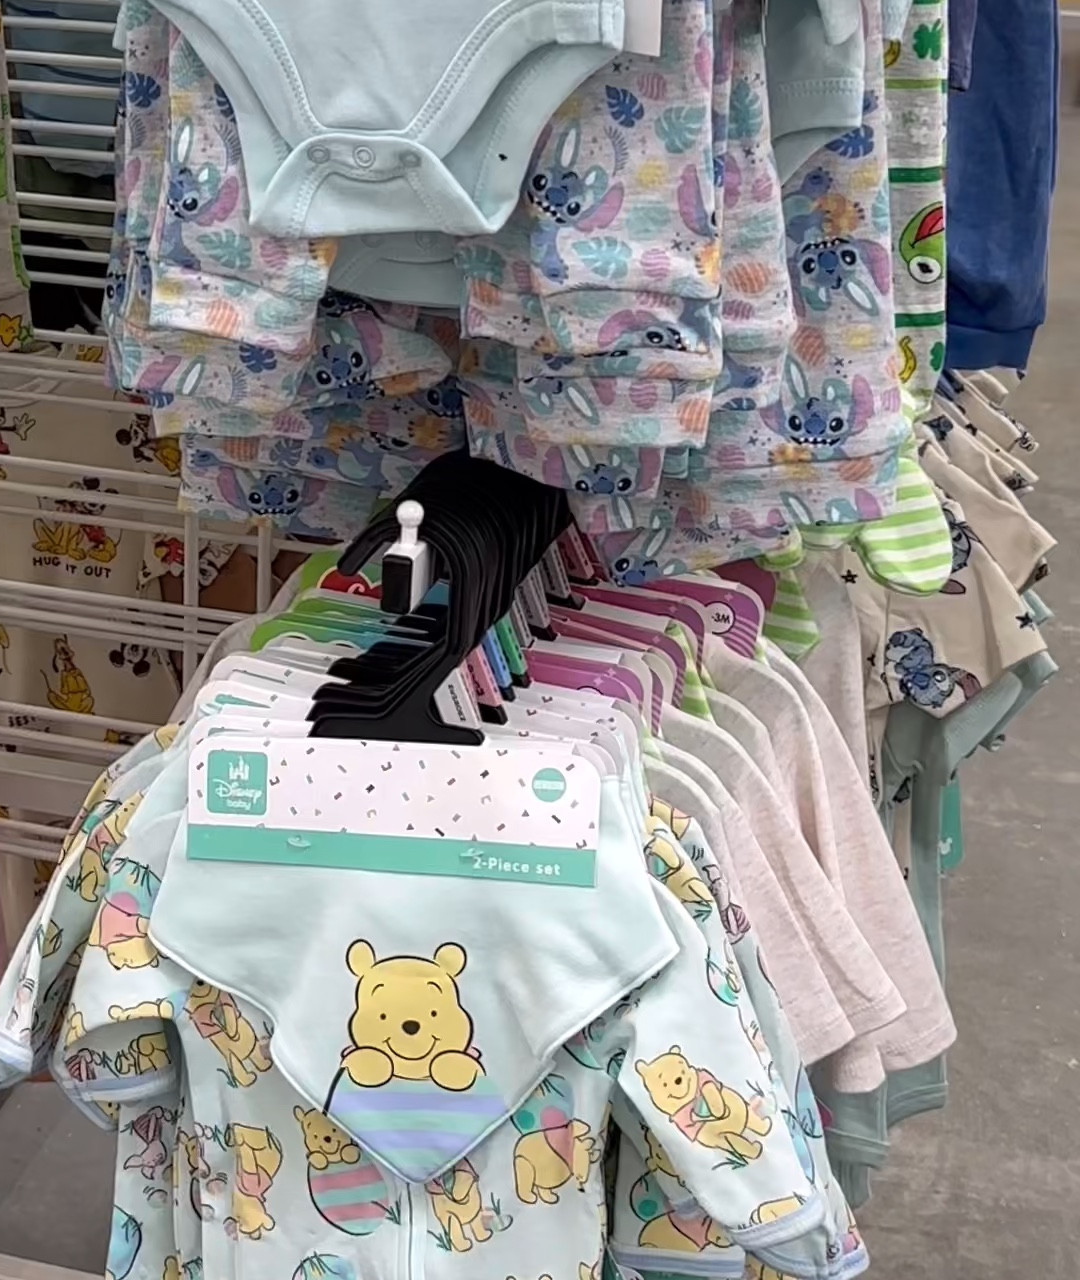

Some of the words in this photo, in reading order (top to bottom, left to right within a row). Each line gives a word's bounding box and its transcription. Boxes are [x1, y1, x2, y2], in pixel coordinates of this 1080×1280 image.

[32, 556, 62, 568] HUG
[65, 563, 78, 575] IT
[83, 565, 112, 579] OUT
[710, 612, 731, 625] -3M
[212, 778, 263, 805] Disney
[472, 855, 529, 874] 2-Piece
[535, 861, 561, 876] set
